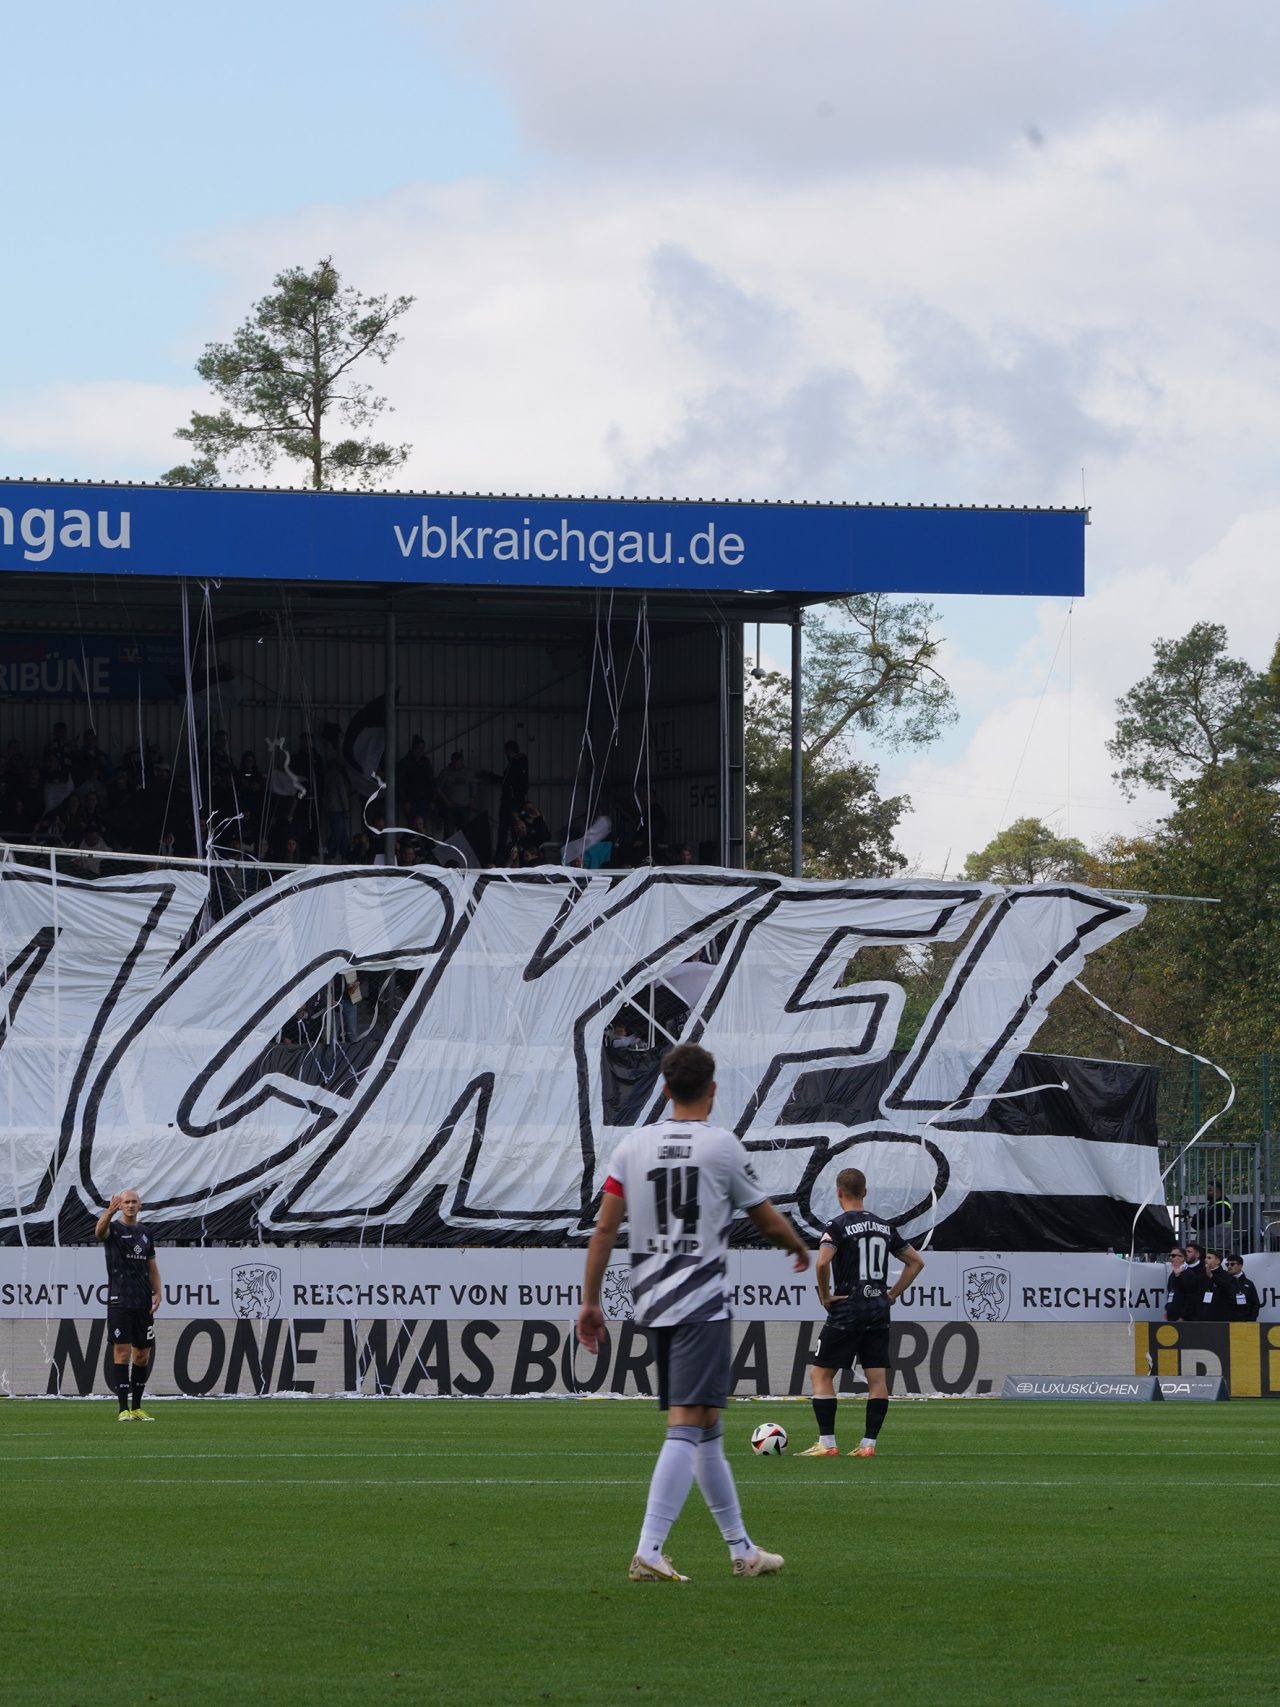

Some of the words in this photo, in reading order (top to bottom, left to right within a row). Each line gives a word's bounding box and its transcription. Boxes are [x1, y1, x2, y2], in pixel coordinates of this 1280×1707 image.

[393, 515, 745, 574] vbkraichgau.de
[647, 1166, 699, 1235] 14
[858, 1236, 887, 1281] 10
[76, 1283, 108, 1306] VO
[164, 1283, 220, 1306] UHL
[293, 1284, 441, 1306] REICHSRAT
[450, 1284, 508, 1306] VON
[729, 1284, 807, 1306] HSRAT
[901, 1286, 952, 1307] UHL
[1023, 1287, 1165, 1309] REICHSRAT
[174, 1318, 326, 1396] ONE
[344, 1318, 501, 1396] WAS
[510, 1319, 660, 1397] BOR
[1033, 1381, 1140, 1395] LUXUSKÜCHEN
[1160, 1383, 1191, 1394] DA
